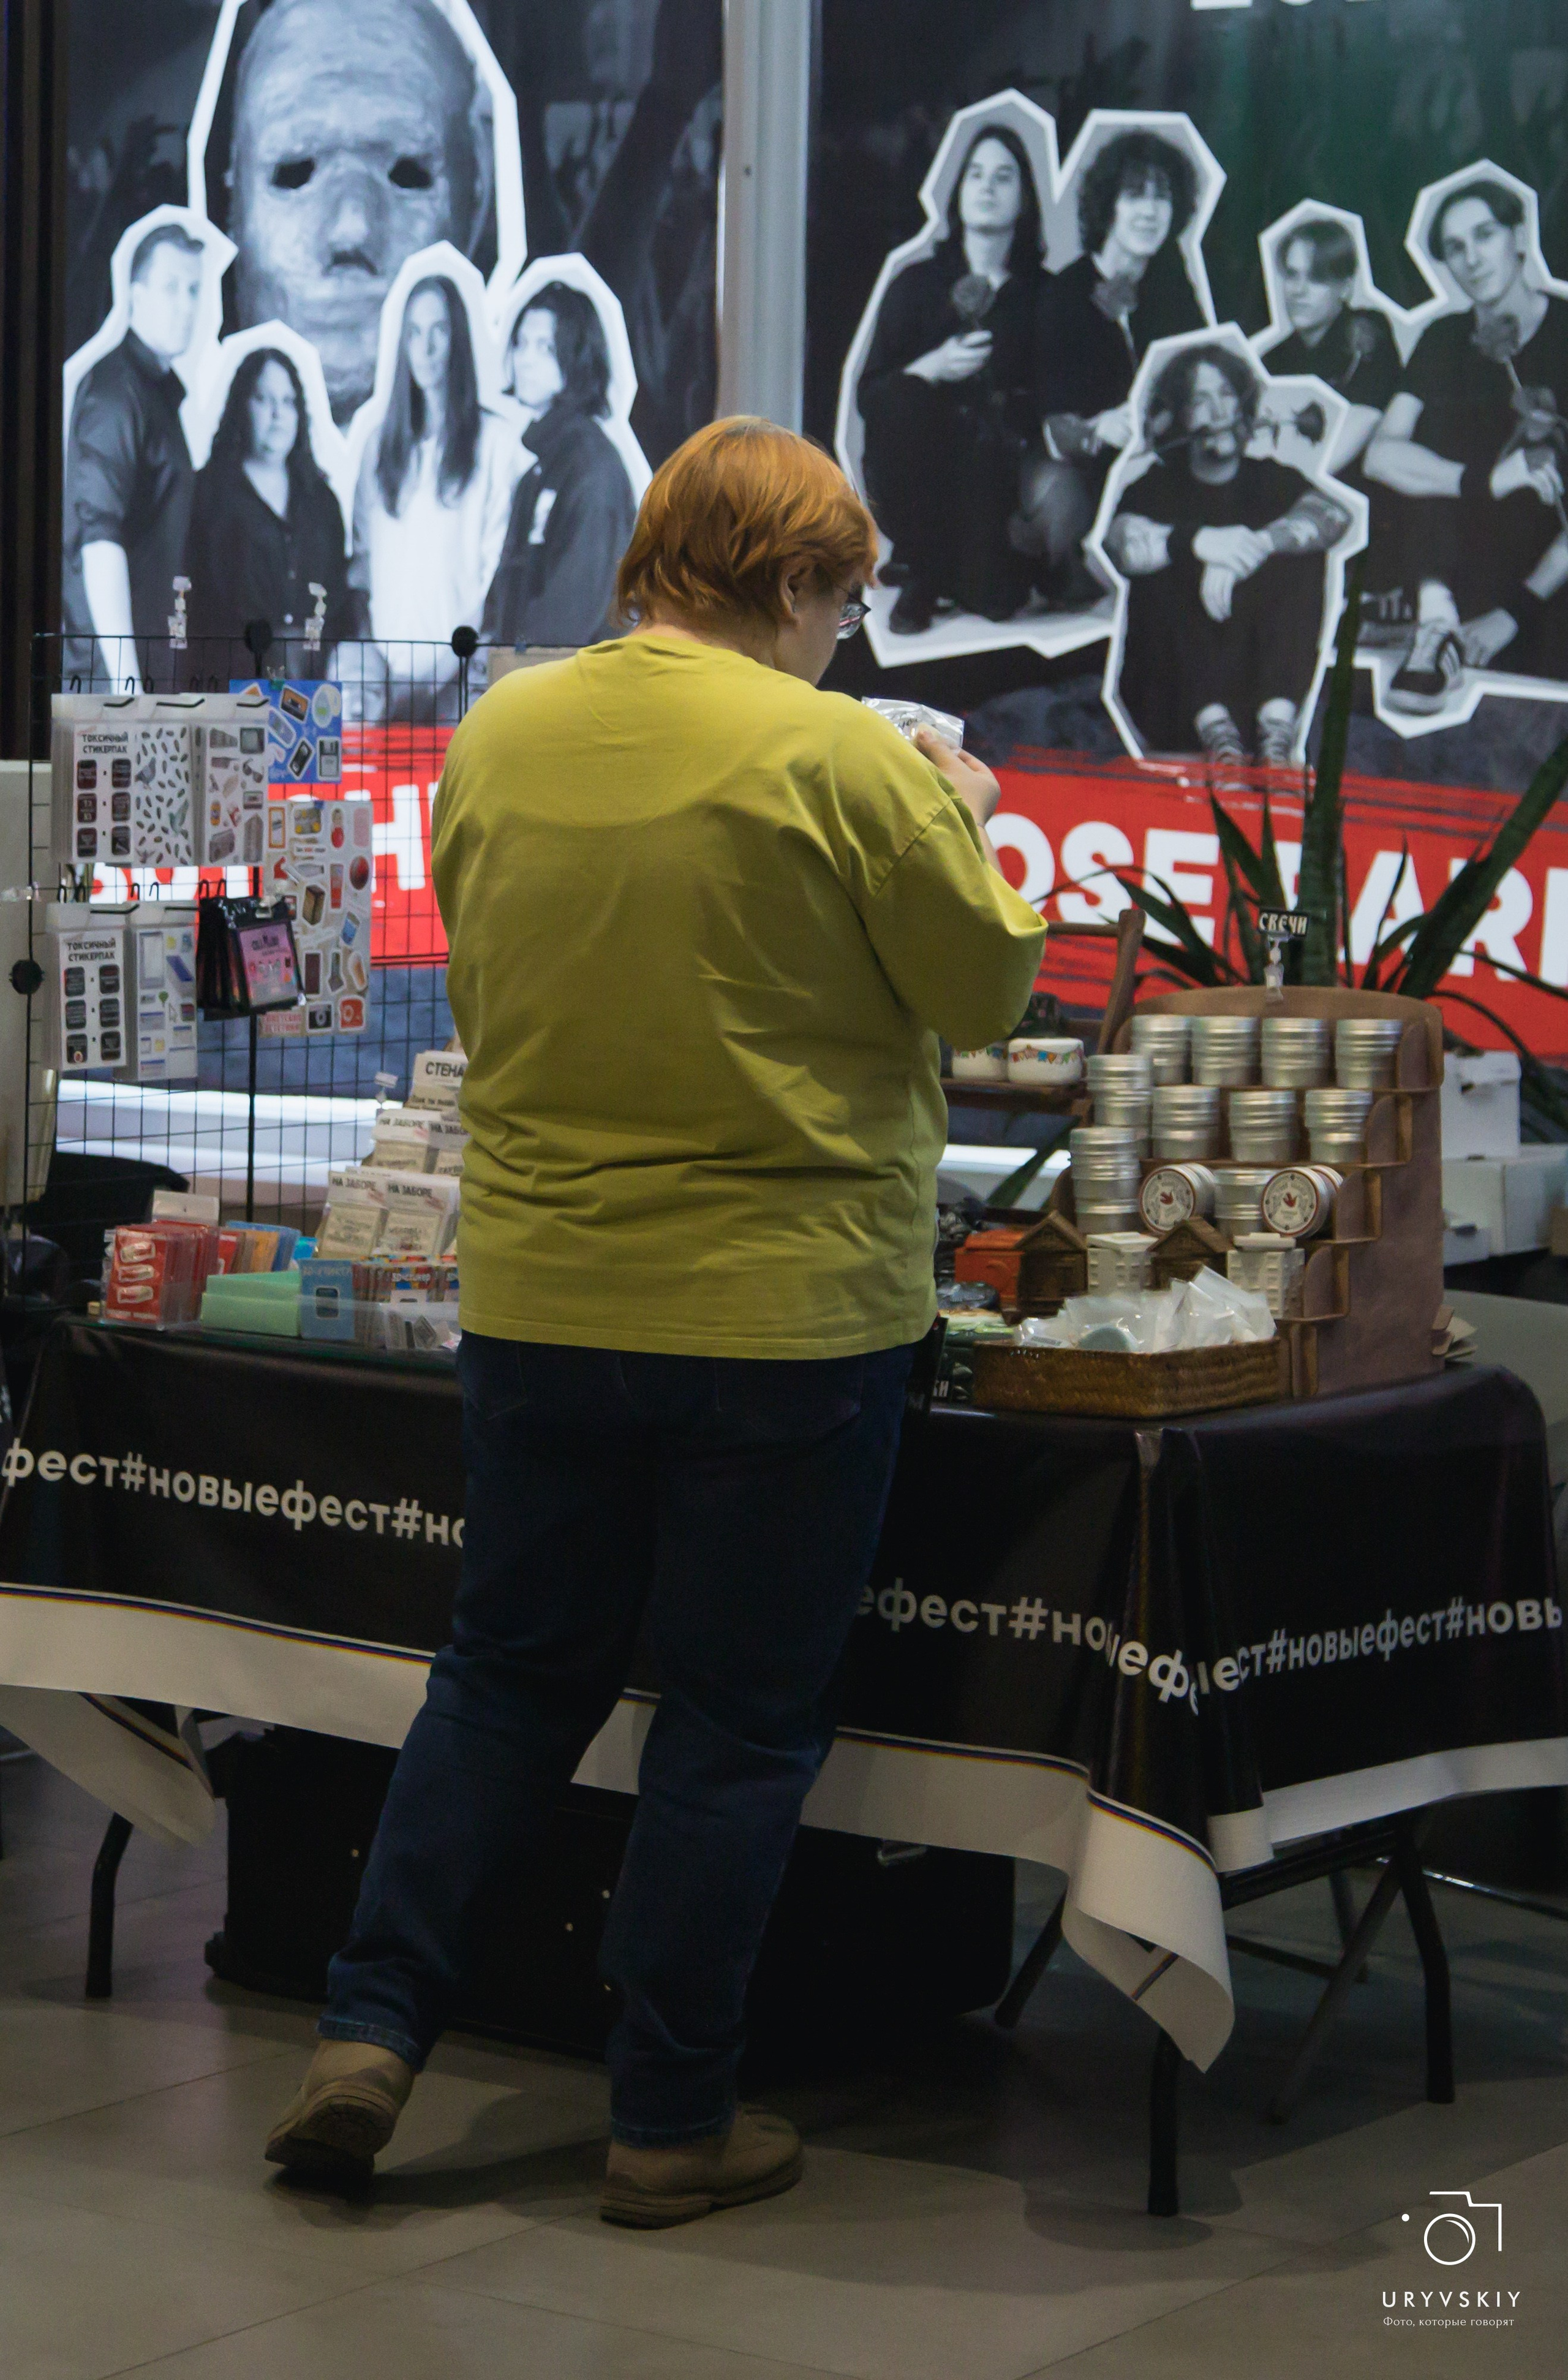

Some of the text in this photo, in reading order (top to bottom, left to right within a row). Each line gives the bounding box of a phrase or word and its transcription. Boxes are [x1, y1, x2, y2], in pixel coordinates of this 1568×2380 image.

[83, 745, 127, 754] СТИКЕРПАК
[1259, 913, 1308, 935] СВЕЧИ
[67, 937, 116, 950] ТОКСИЧНЫЙ
[69, 951, 115, 961] СТИКЕРПАК
